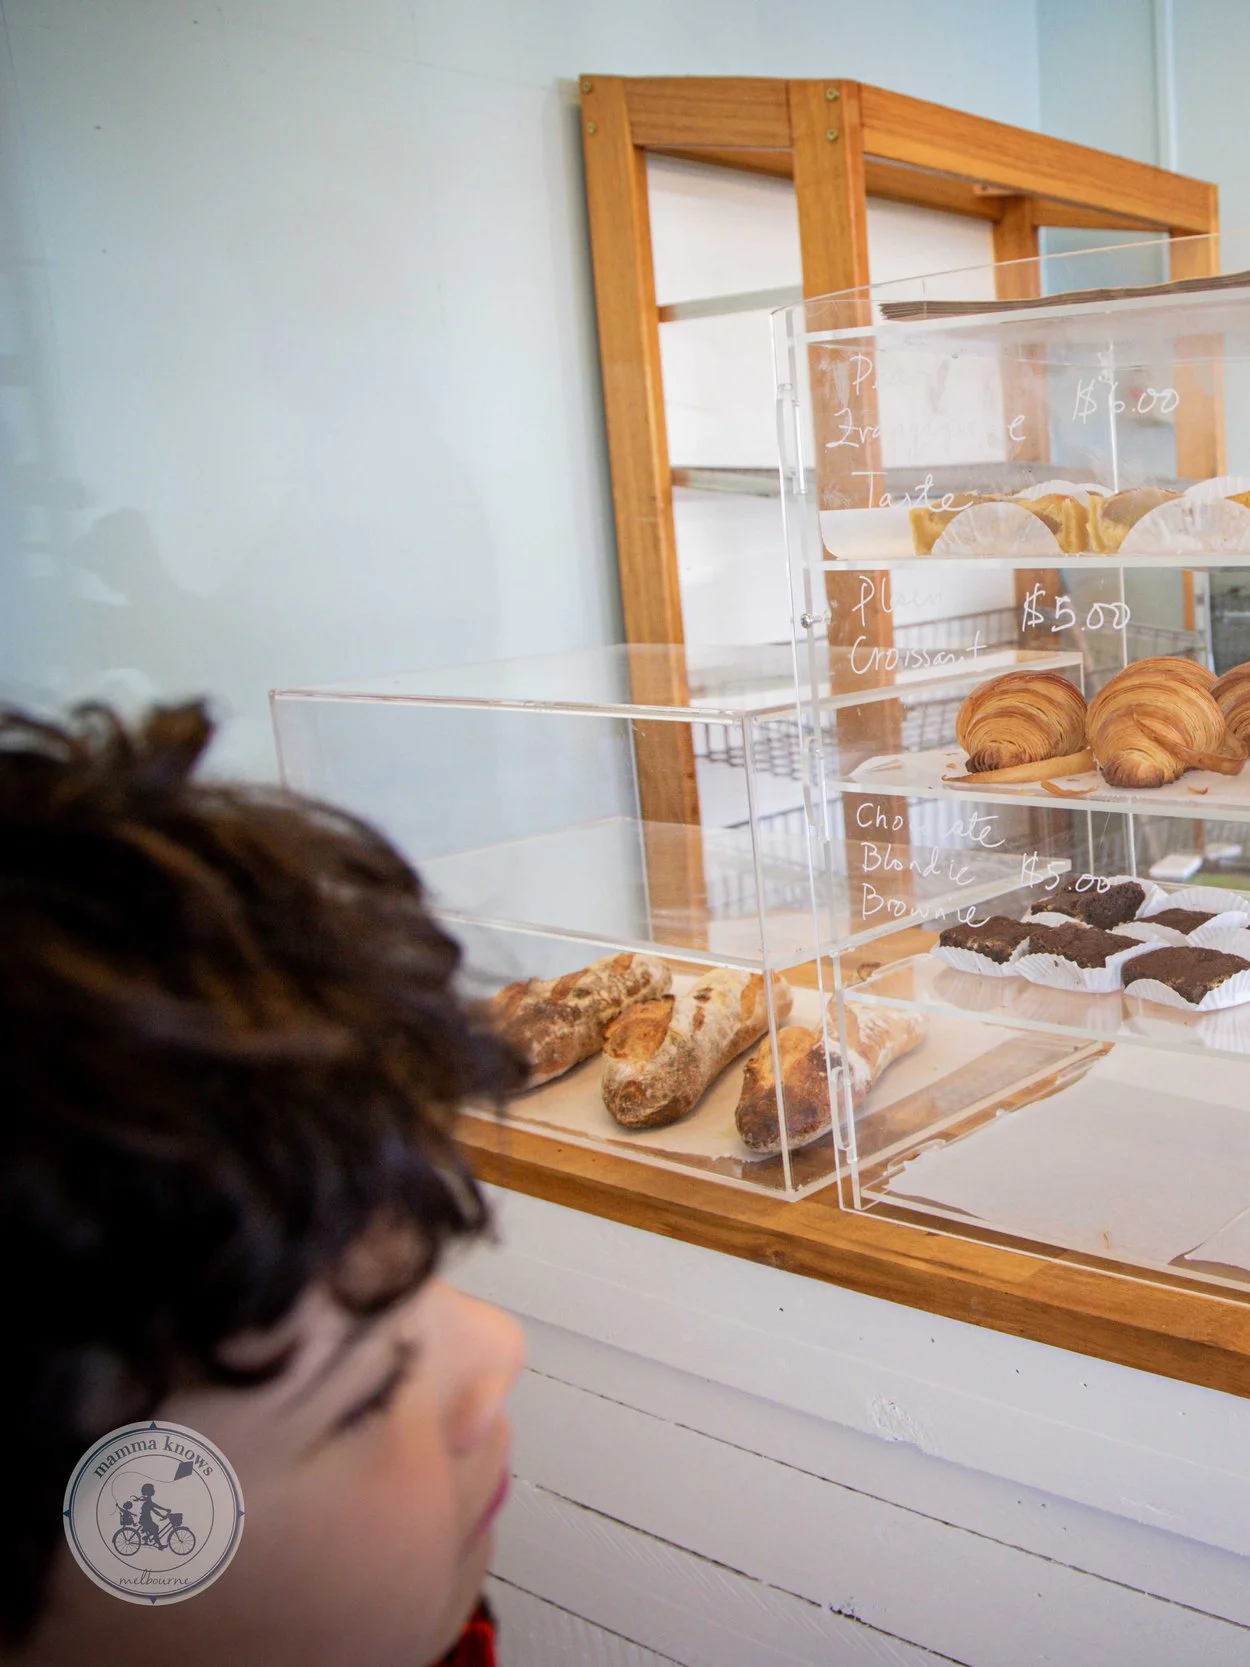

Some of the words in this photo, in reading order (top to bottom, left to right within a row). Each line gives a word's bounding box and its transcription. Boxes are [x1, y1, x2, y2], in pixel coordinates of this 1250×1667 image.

[1073, 378, 1181, 424] $6.00
[1021, 582, 1132, 633] $5.00
[850, 630, 988, 675] Croissant
[856, 803, 1006, 848] Choate
[861, 842, 977, 886] Blondie
[1020, 851, 1112, 893] $5.00
[862, 883, 992, 928] Brownie
